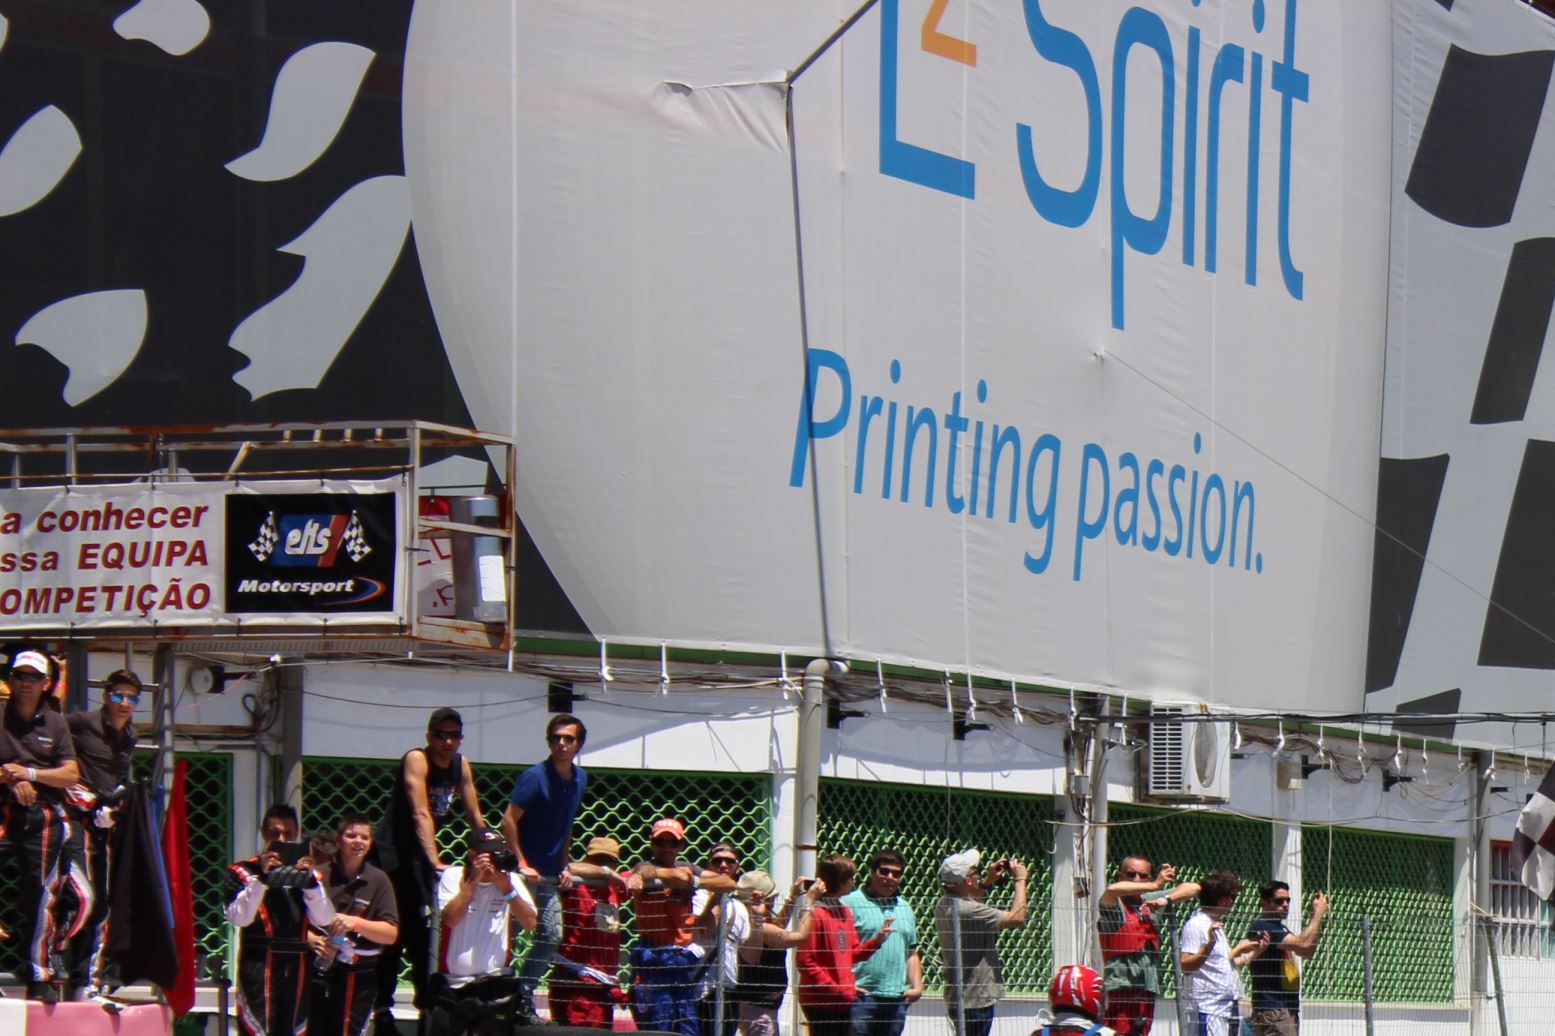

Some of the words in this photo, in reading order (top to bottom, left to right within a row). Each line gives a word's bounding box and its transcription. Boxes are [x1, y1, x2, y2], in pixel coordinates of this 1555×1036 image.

[1016, 0, 1309, 331] Spirit
[789, 347, 1062, 576] Printing
[1072, 432, 1263, 582] passion.
[36, 501, 209, 533] conhecer
[77, 539, 209, 570] EQUIPA
[0, 577, 211, 618] OMPETIÇÃO
[237, 579, 355, 596] Motorsport
